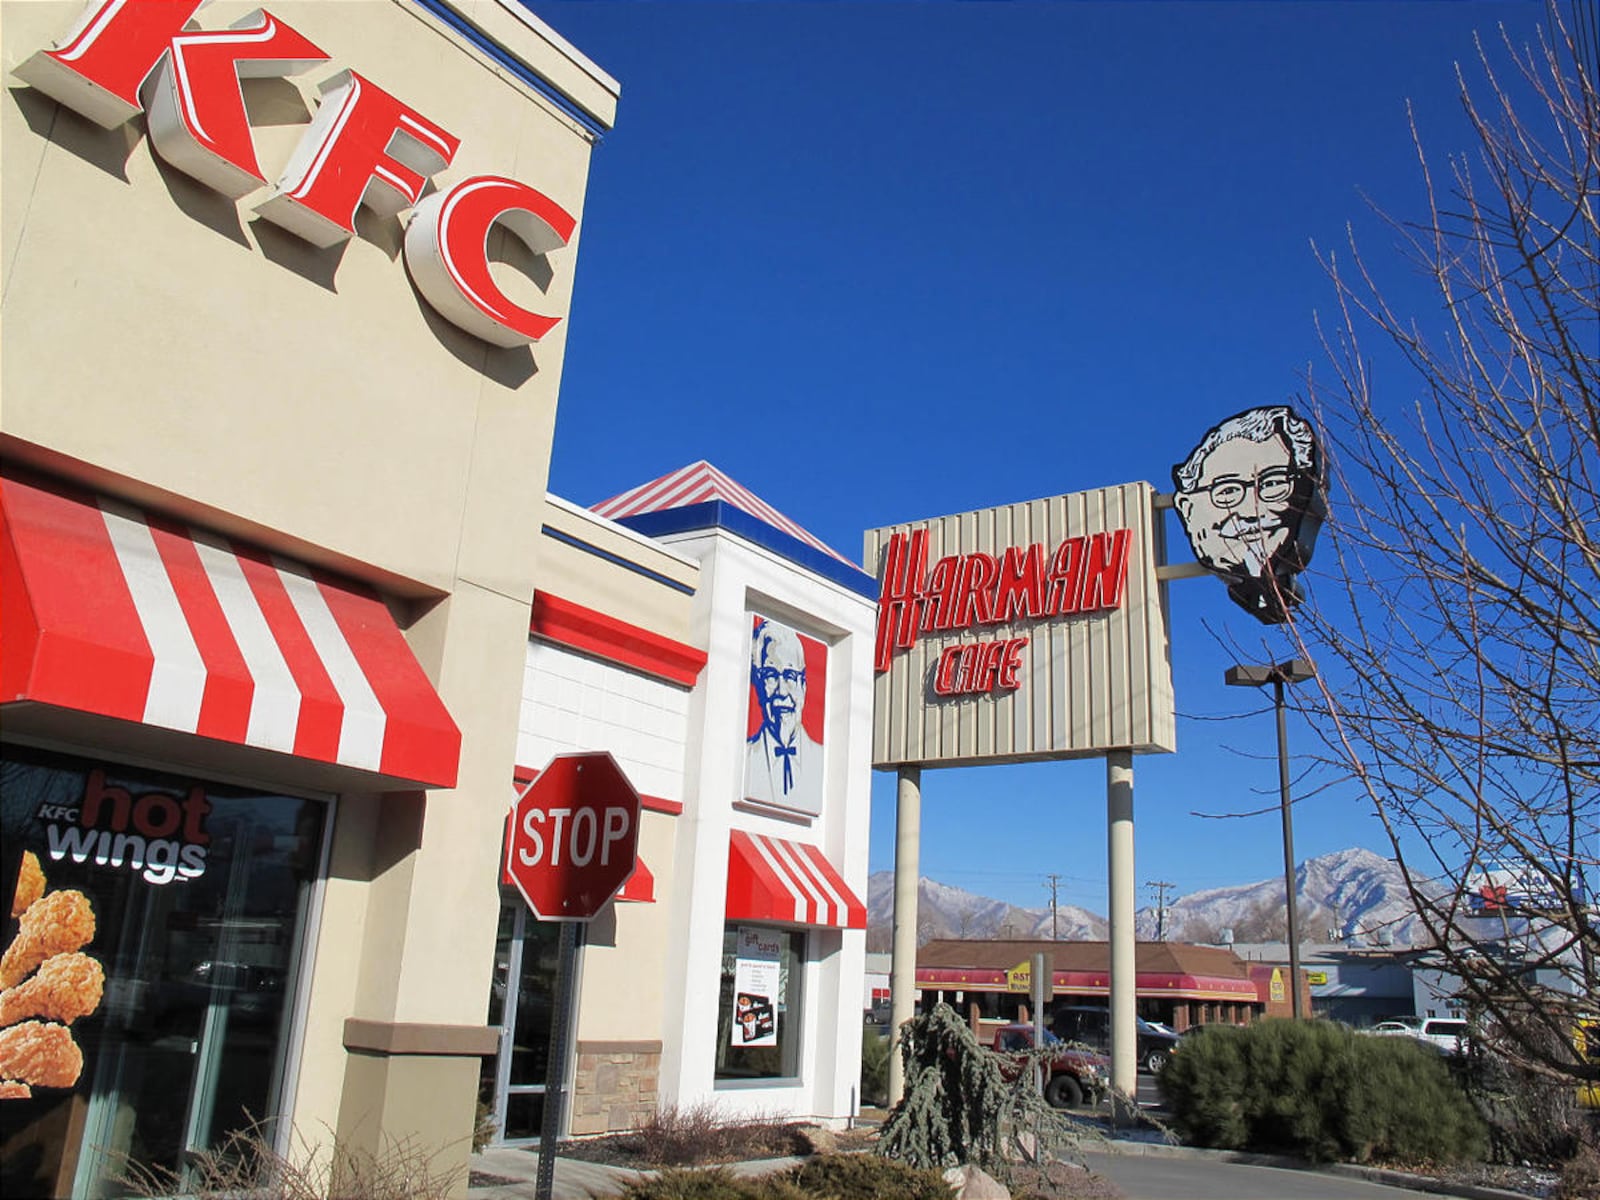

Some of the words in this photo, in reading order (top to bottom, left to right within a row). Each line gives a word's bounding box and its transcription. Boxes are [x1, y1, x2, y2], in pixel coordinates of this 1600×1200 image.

[14, 0, 577, 346] KFC
[934, 637, 1029, 695] CAFE
[38, 804, 80, 822] KFC
[81, 769, 213, 844] hot
[519, 806, 629, 866] STOP
[47, 824, 207, 885] wings
